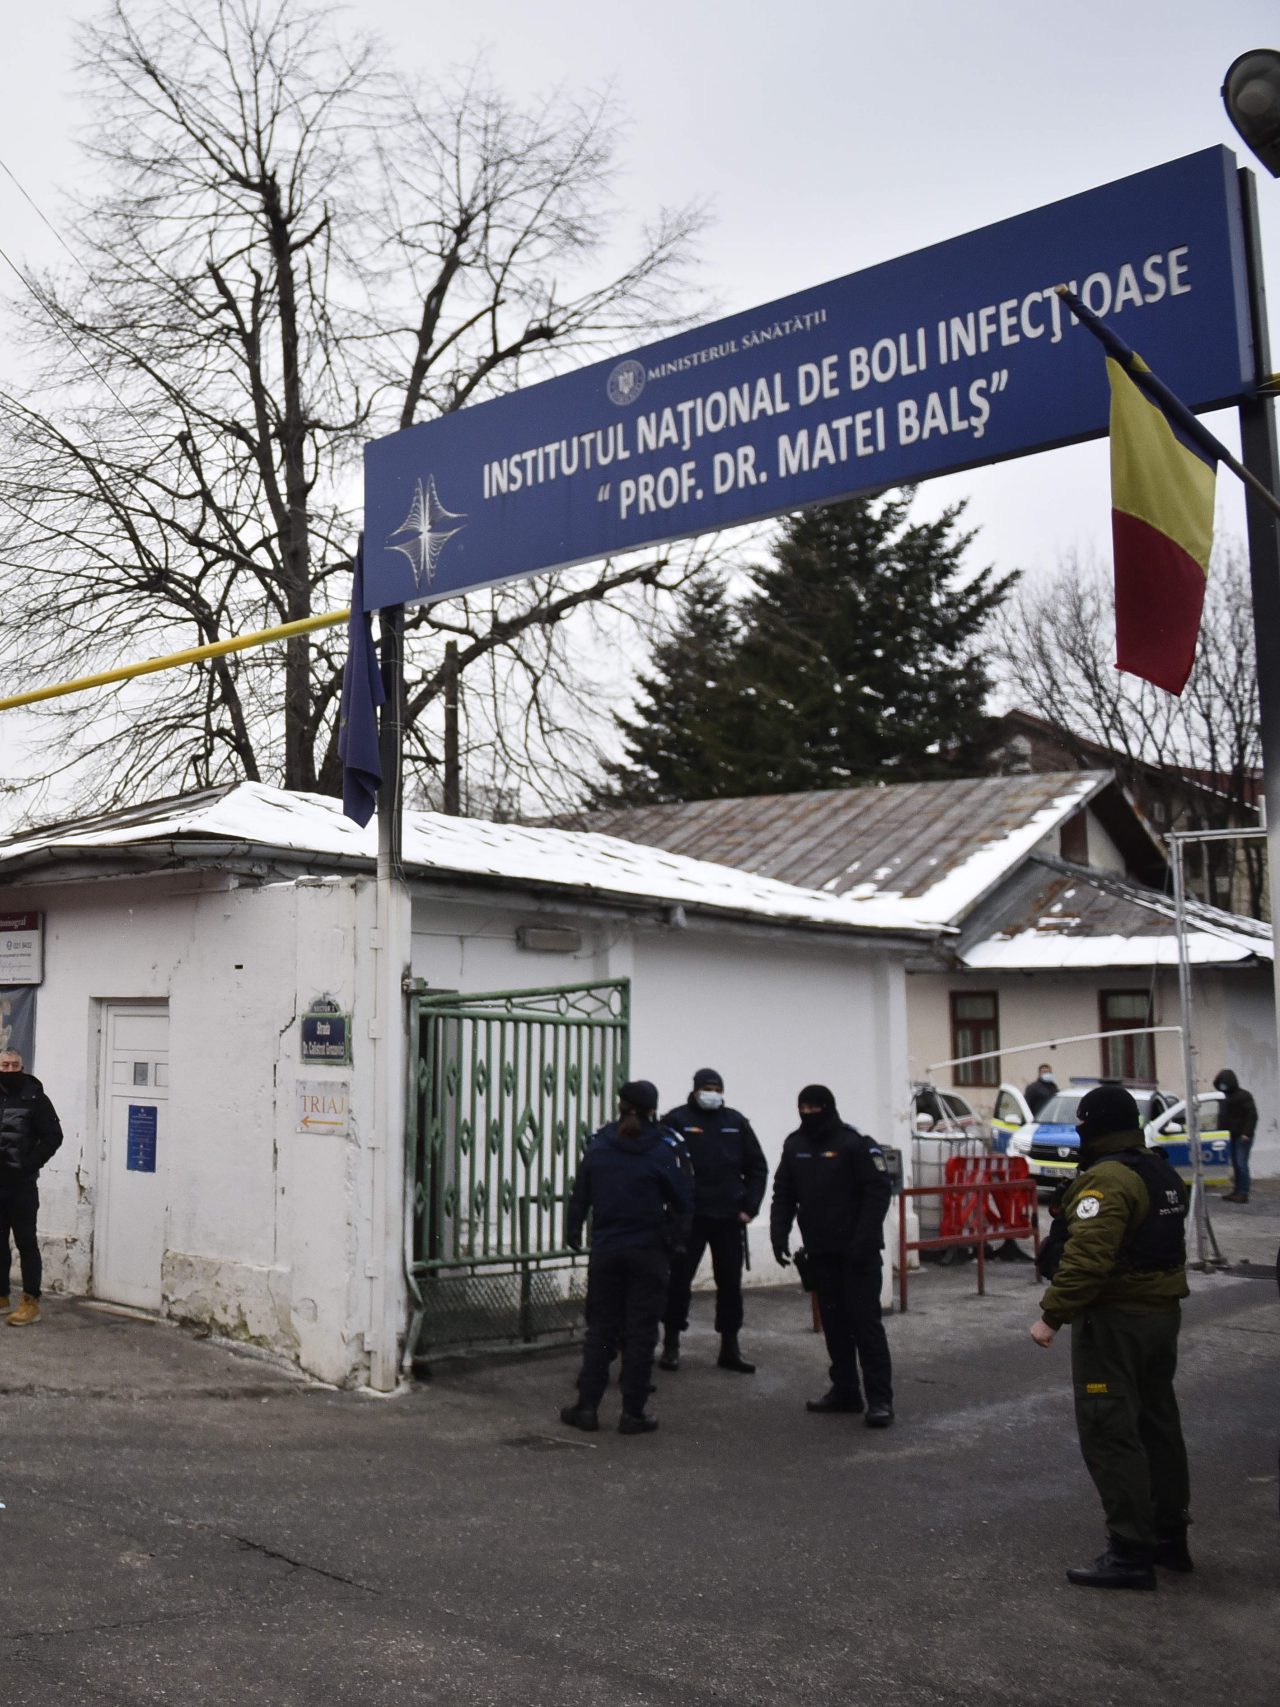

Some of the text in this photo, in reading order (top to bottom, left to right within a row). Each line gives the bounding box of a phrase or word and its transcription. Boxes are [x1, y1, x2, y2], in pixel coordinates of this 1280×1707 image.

[646, 340, 740, 381] MINISTERUL
[482, 421, 631, 500] INSTITUTUL
[798, 354, 840, 407] DE
[849, 327, 928, 391] BOLI
[713, 444, 769, 496] DR.
[777, 406, 887, 479] MATEI
[301, 1095, 345, 1115] TRIAJ
